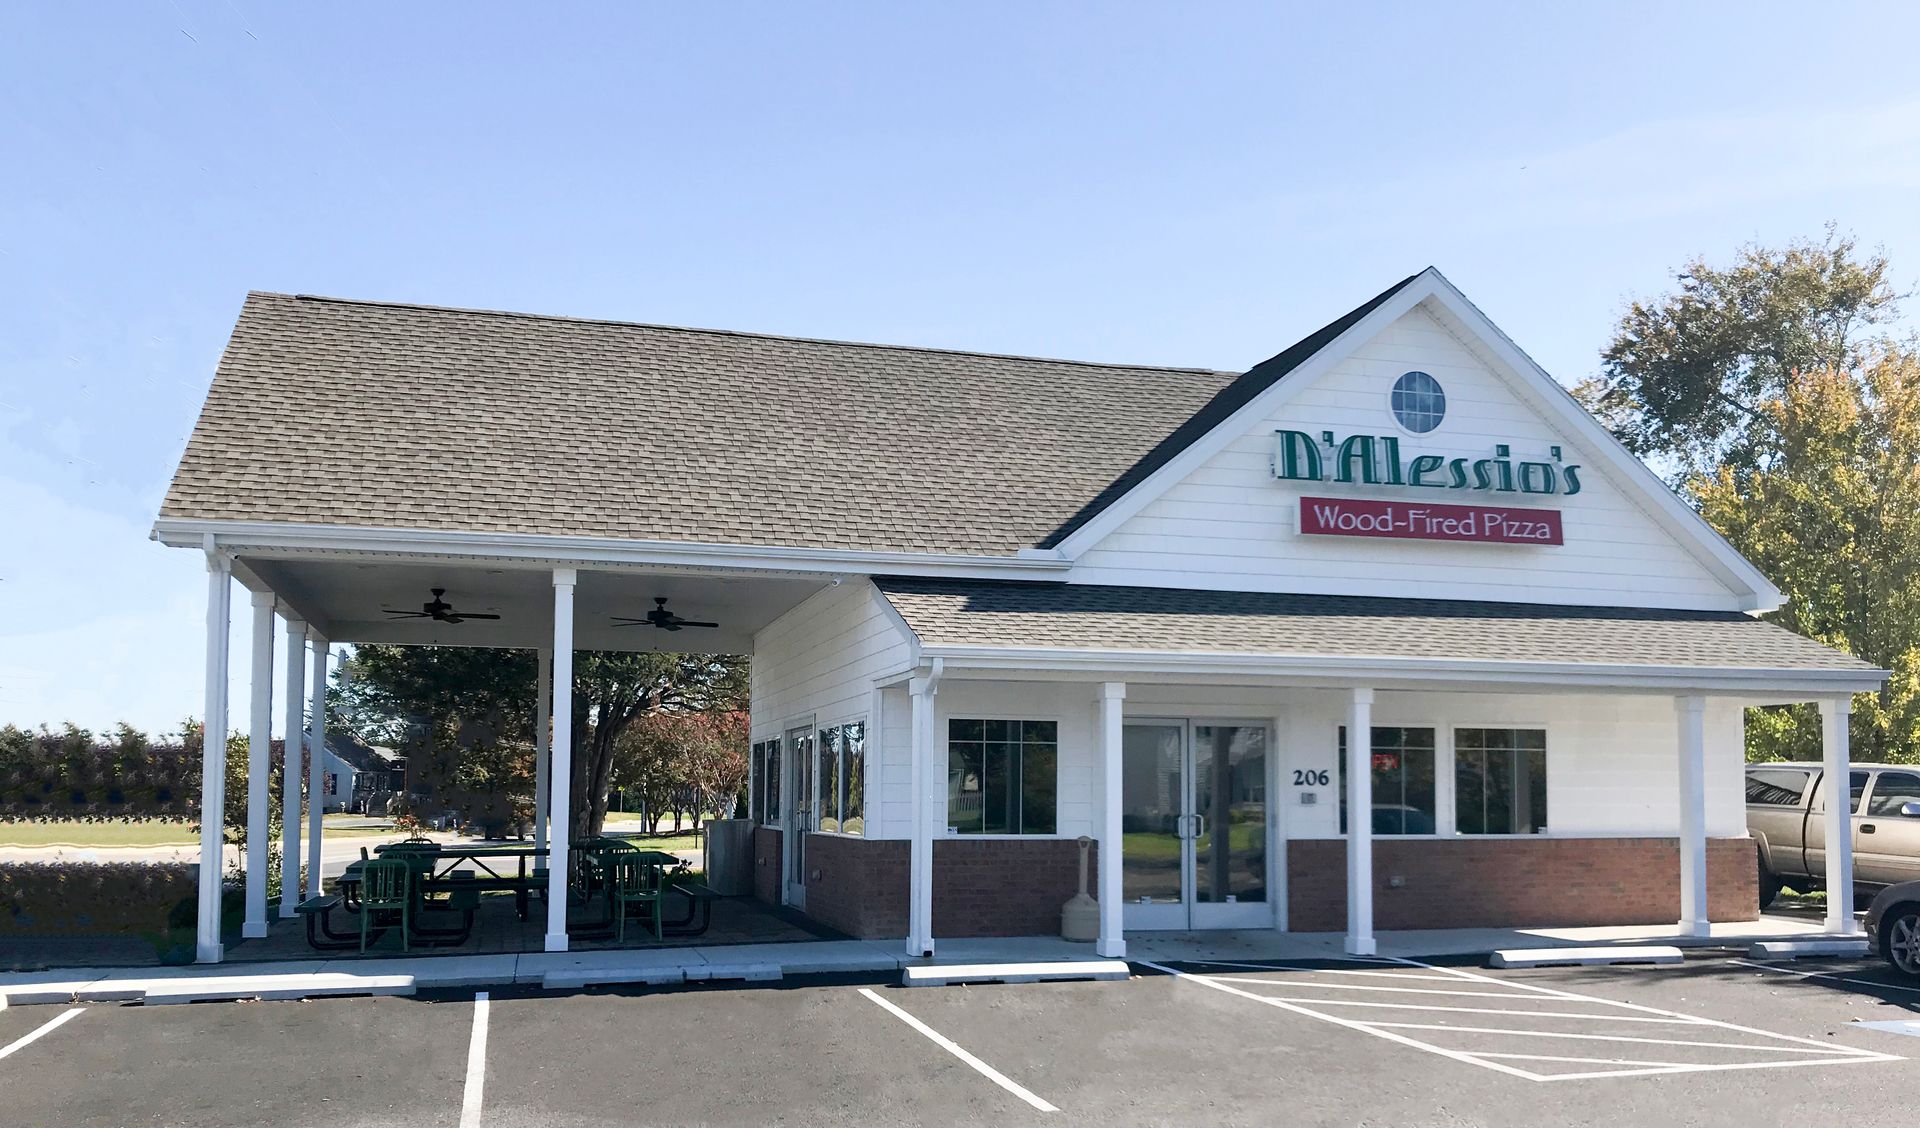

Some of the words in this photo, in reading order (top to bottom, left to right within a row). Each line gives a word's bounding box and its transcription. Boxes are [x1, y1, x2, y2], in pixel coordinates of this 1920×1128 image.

[1274, 429, 1581, 495] D'Alessio's
[1313, 505, 1476, 535] Wood-Fired
[1484, 513, 1551, 539] Pizza
[1293, 769, 1329, 786] 206
